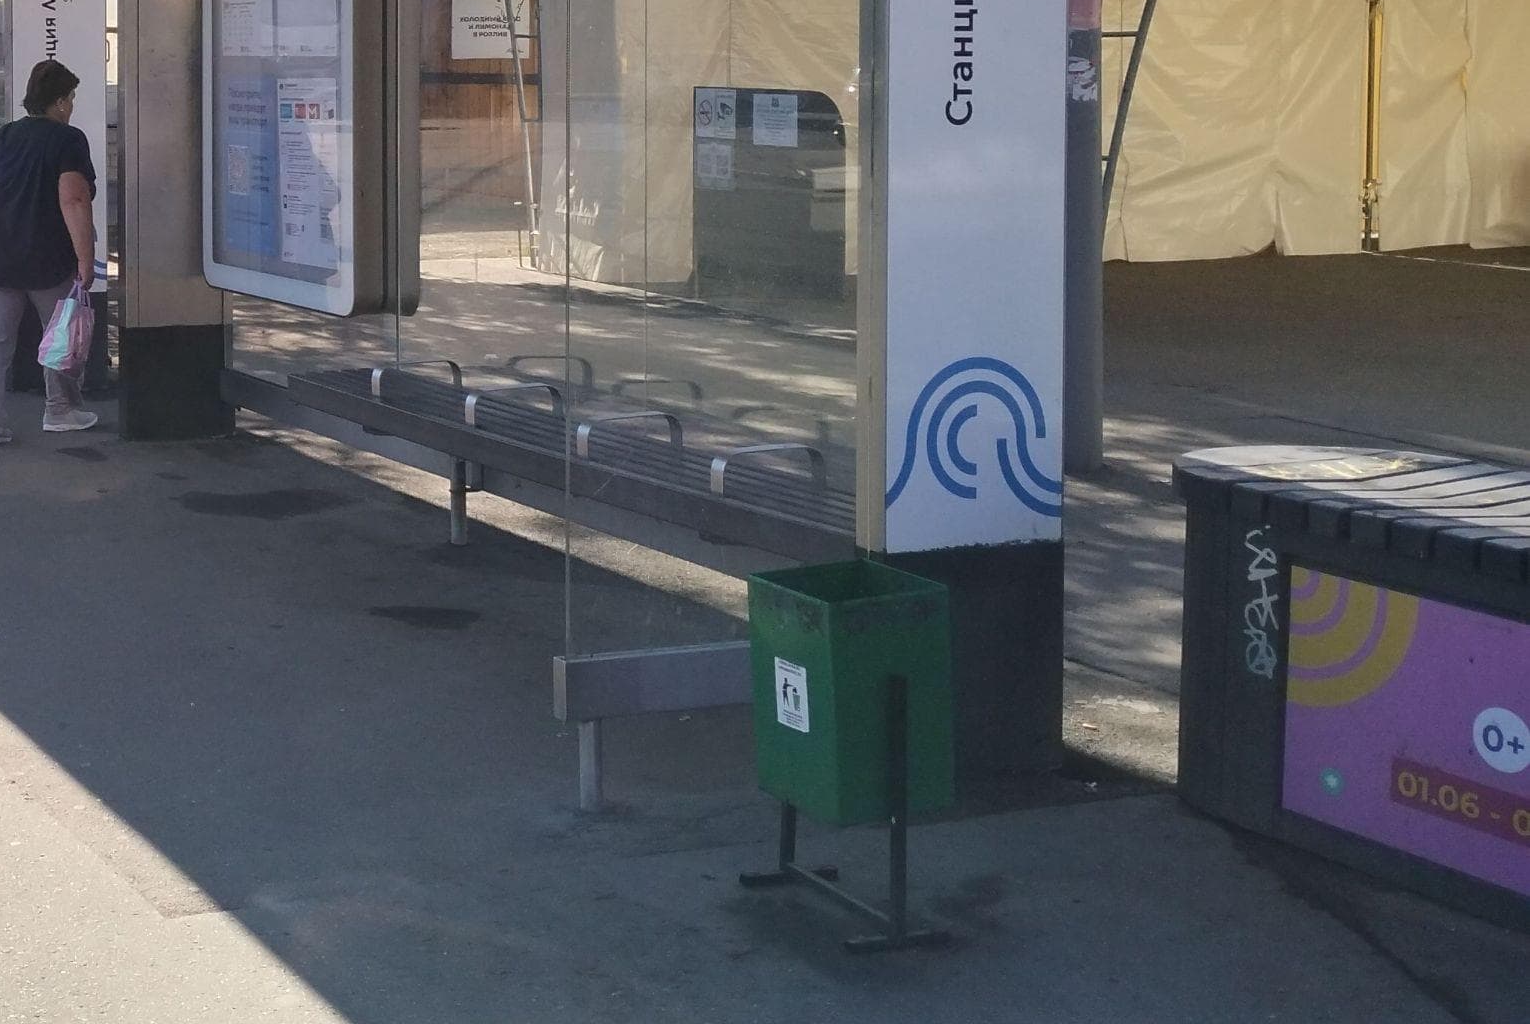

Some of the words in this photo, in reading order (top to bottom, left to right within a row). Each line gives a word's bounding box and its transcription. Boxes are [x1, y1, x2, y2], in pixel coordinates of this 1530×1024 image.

[45, 17, 58, 60] нция
[1483, 725, 1524, 754] 0+
[1398, 772, 1480, 819] 01.06
